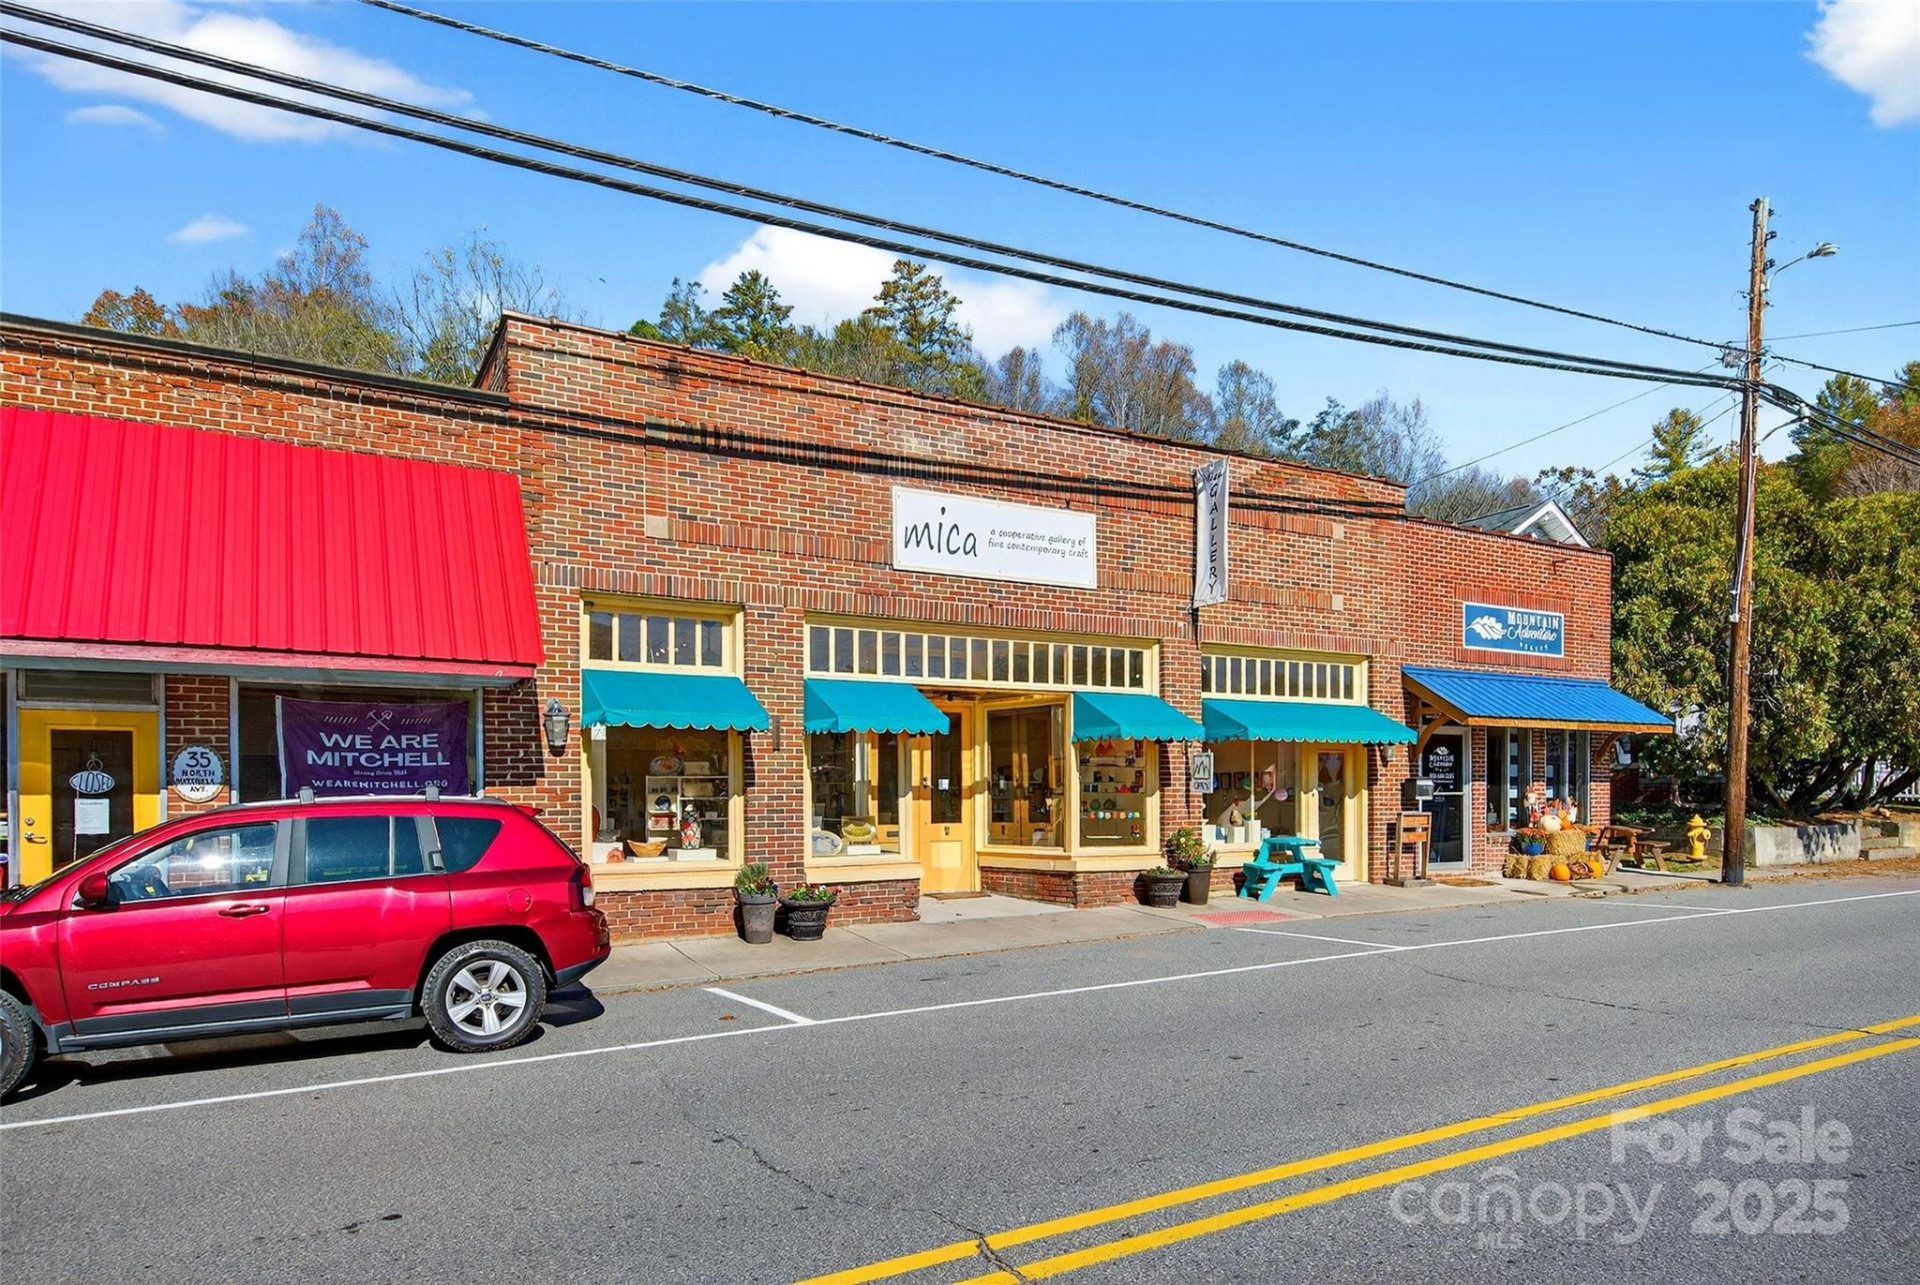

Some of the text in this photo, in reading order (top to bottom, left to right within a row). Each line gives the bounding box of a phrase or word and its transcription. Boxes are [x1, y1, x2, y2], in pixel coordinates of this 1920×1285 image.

[904, 506, 977, 558] mica
[990, 528, 1087, 548] a cooperative gallery of
[1208, 482, 1220, 595] GALLERY
[988, 539, 1004, 549] fine
[1006, 542, 1066, 558] contemporary
[1507, 611, 1559, 629] MOUNTAIN
[319, 732, 439, 750] WE ARE
[185, 751, 212, 768] 35
[306, 750, 450, 767] MITCHELL
[71, 771, 113, 793] CLOSED
[181, 769, 215, 778] NORTH
[88, 976, 160, 990] COMPASS
